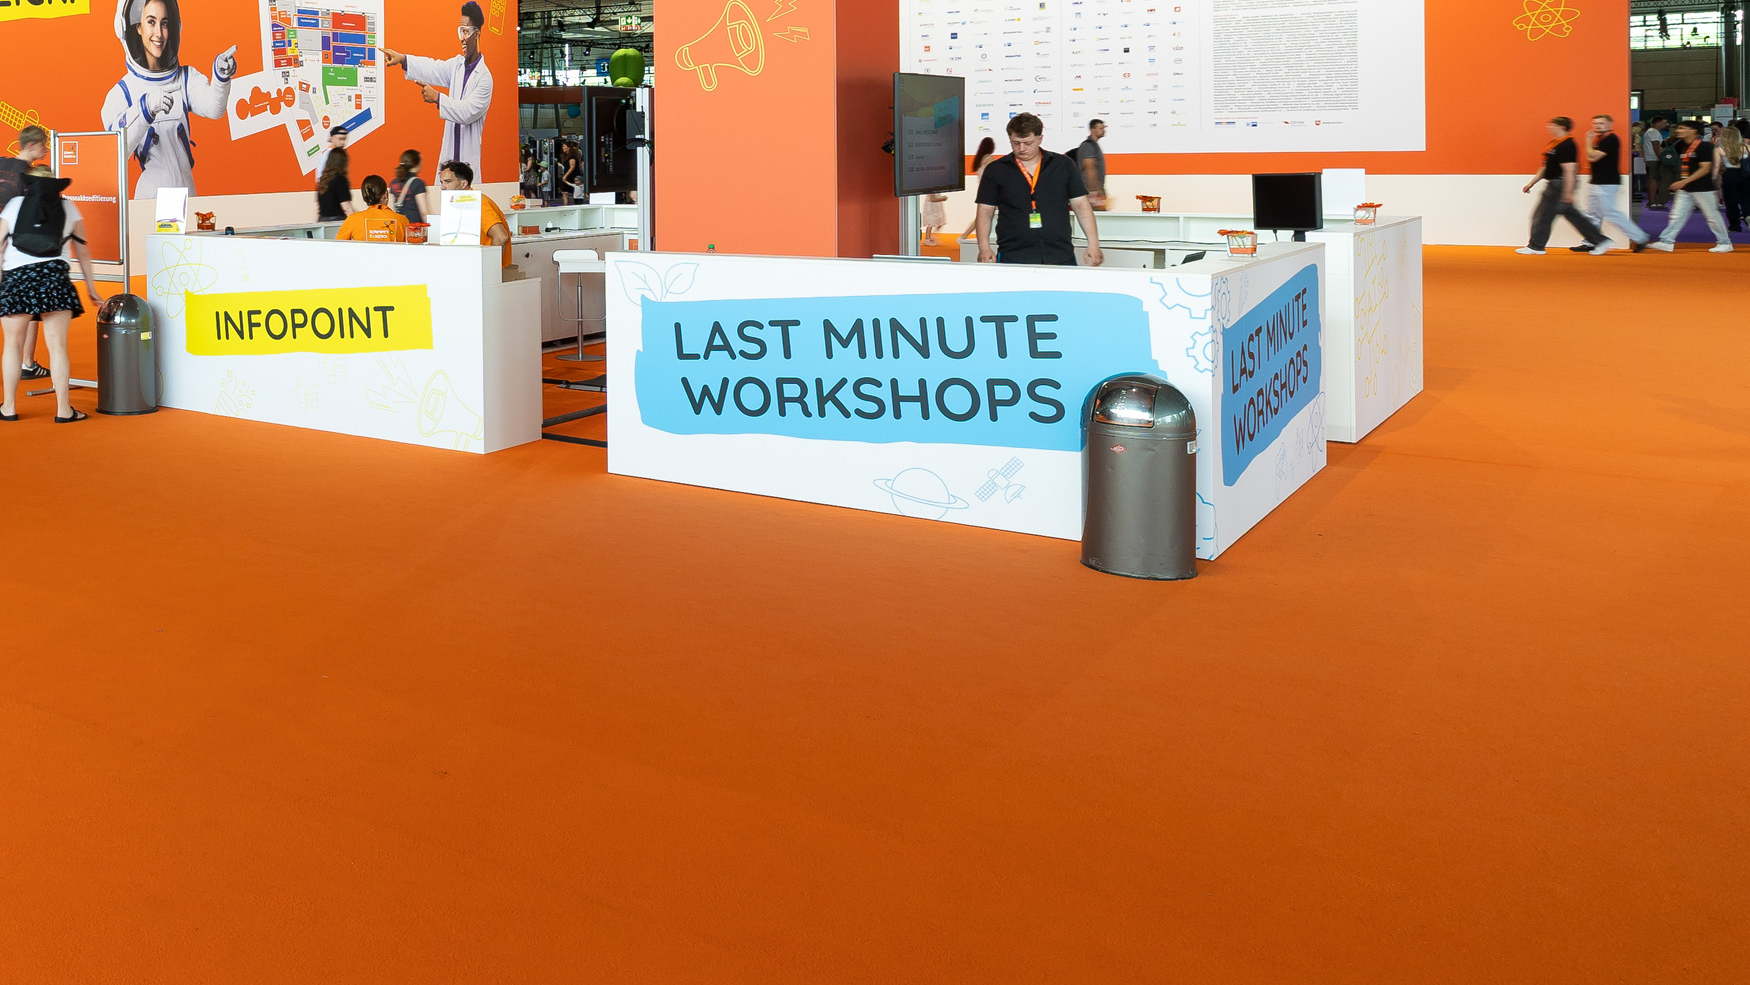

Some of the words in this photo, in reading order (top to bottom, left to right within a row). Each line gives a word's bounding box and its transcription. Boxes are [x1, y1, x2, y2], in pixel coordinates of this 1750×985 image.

[214, 305, 395, 342] INFOPOINT
[674, 318, 801, 361] LAST
[822, 313, 1063, 360] MINUTE
[1231, 325, 1263, 395] LAST
[1266, 287, 1308, 362] MINUTE
[680, 376, 1067, 424] WORKSHOPS
[1233, 344, 1309, 456] WORKSHOPS
